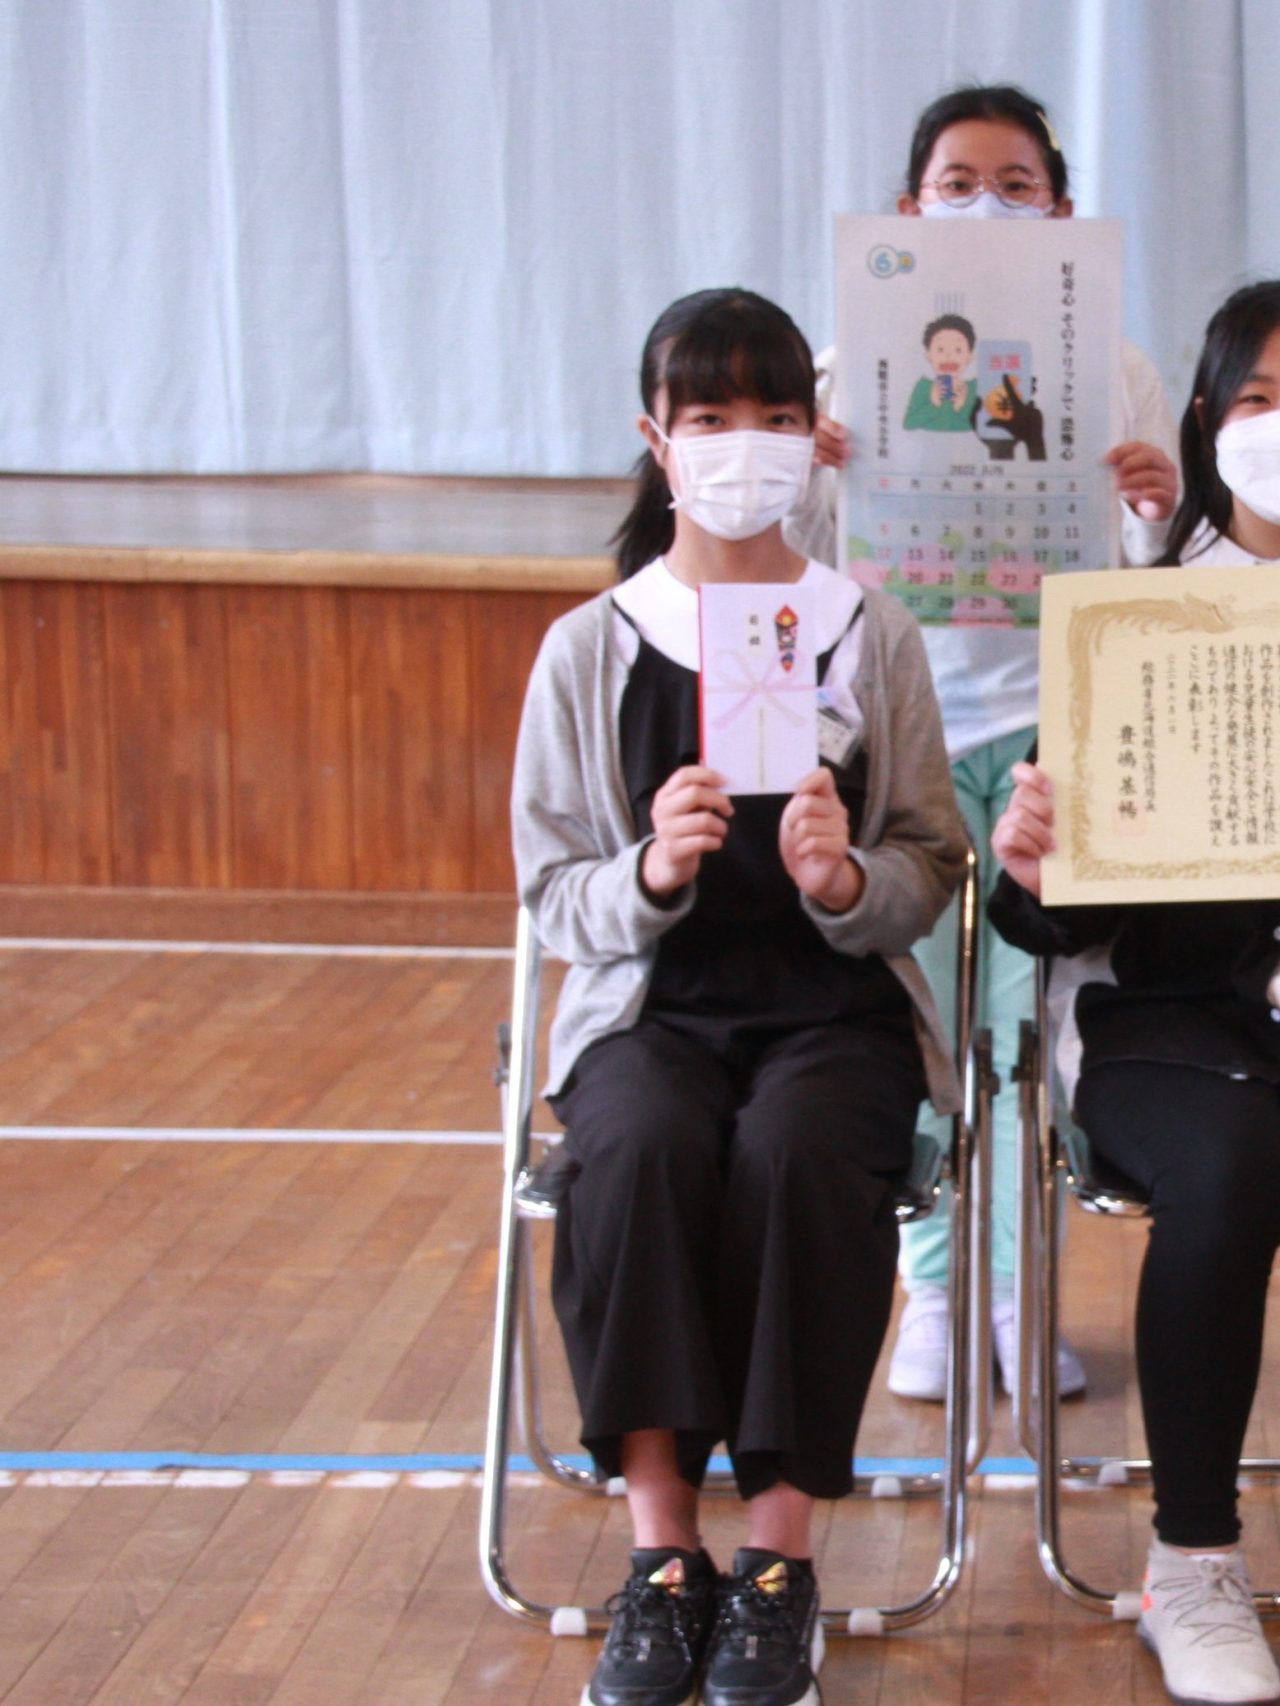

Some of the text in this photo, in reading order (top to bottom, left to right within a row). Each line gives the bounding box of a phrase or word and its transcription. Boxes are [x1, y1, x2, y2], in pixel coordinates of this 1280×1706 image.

[1061, 261, 1075, 307] 好奇心
[1061, 313, 1075, 411] そのクリックで
[975, 503, 1077, 515] 1 2 3 4
[911, 525, 919, 537] 6
[974, 526, 983, 538] 8
[1005, 526, 1014, 538] 9
[1034, 526, 1049, 539] 10
[1065, 526, 1079, 539] 11
[909, 549, 923, 561] 13
[940, 549, 954, 561] 14
[971, 550, 986, 562] 15
[1002, 550, 1018, 562] 16
[1034, 550, 1049, 562] 17
[1065, 550, 1080, 562] 18
[909, 572, 923, 584] 20
[939, 573, 953, 585] 21
[971, 573, 986, 585] 22
[1002, 574, 1018, 586] 23
[1033, 574, 1042, 586] 2
[908, 596, 923, 608] 27
[971, 597, 986, 610] 29
